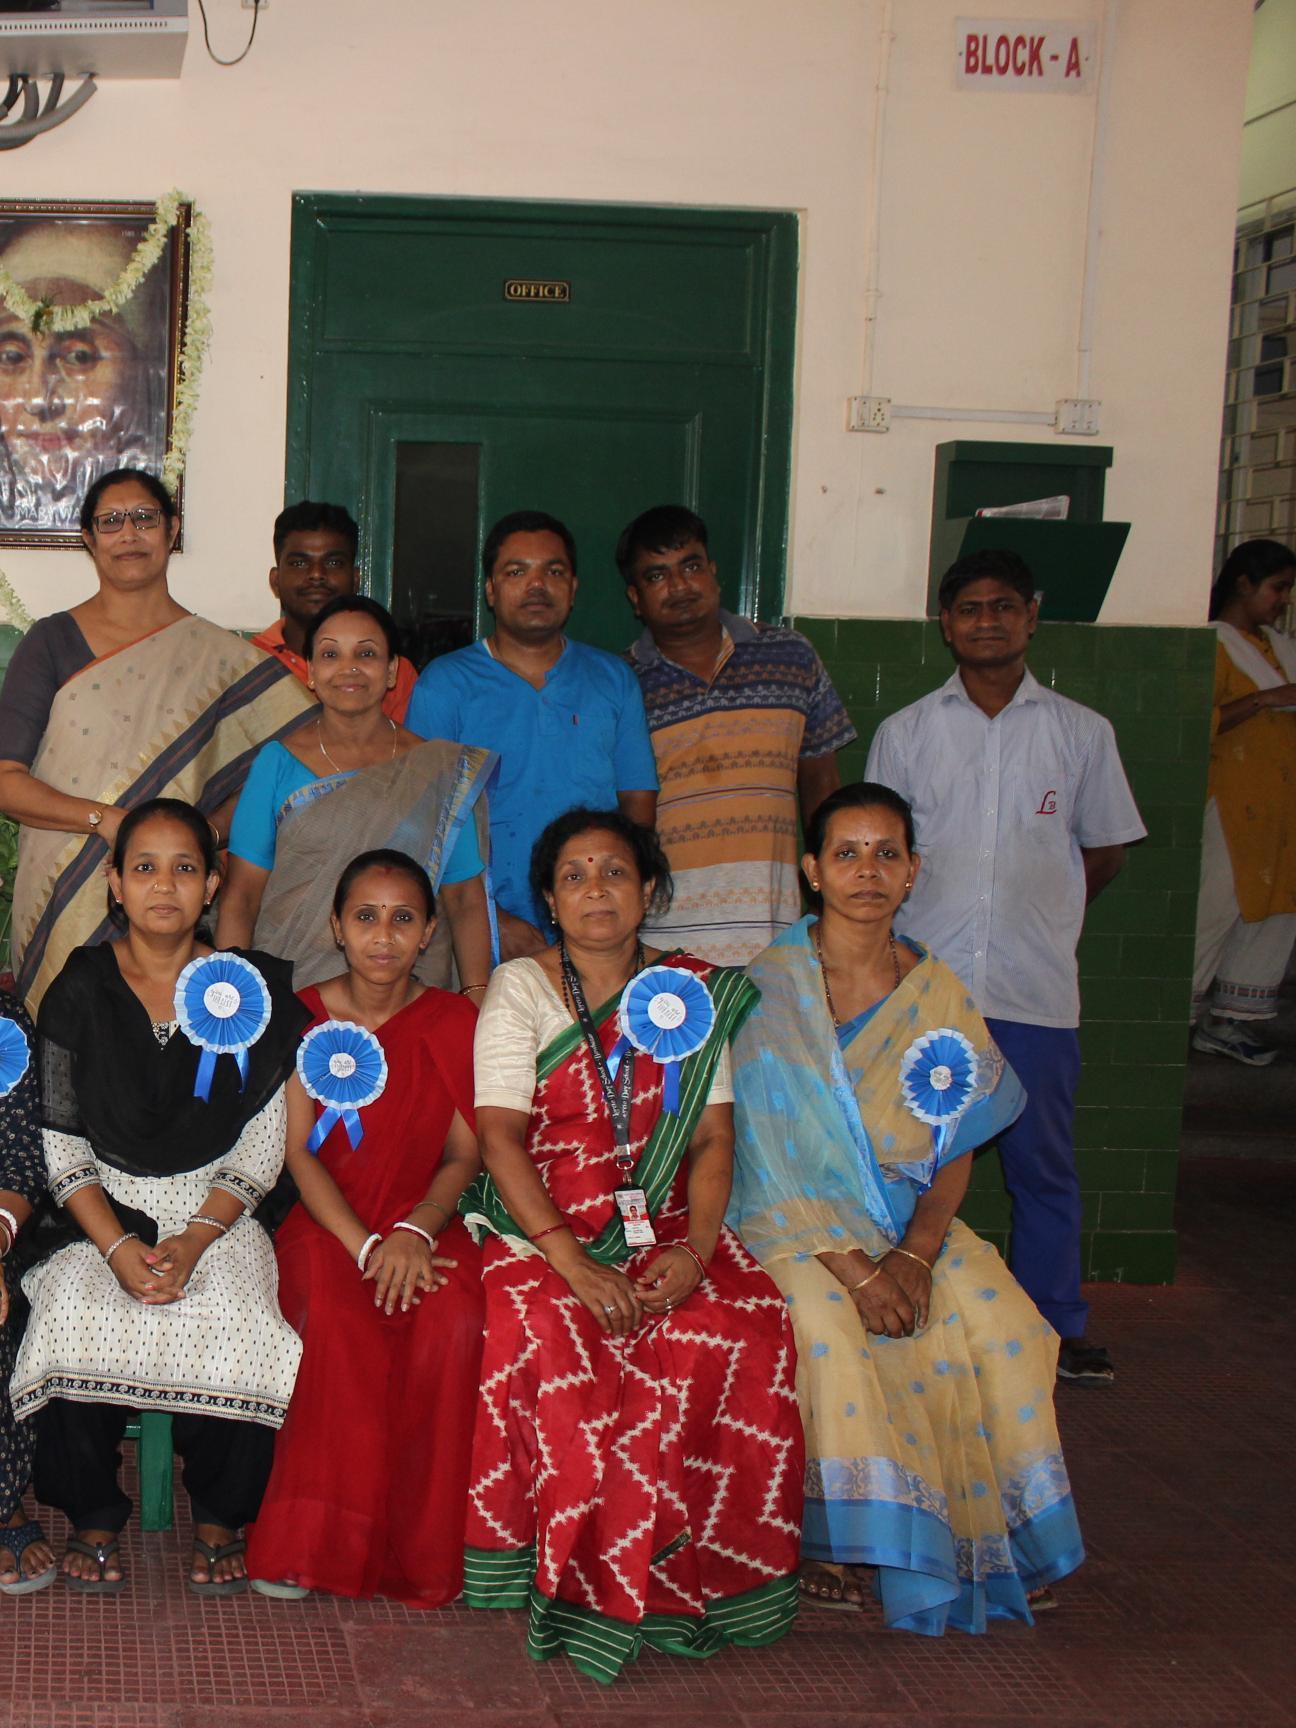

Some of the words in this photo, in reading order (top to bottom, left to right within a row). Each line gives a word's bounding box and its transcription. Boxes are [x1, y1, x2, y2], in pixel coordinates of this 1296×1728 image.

[965, 34, 1046, 76] BLOCK
[1065, 37, 1081, 78] A
[510, 283, 564, 298] OFFICE
